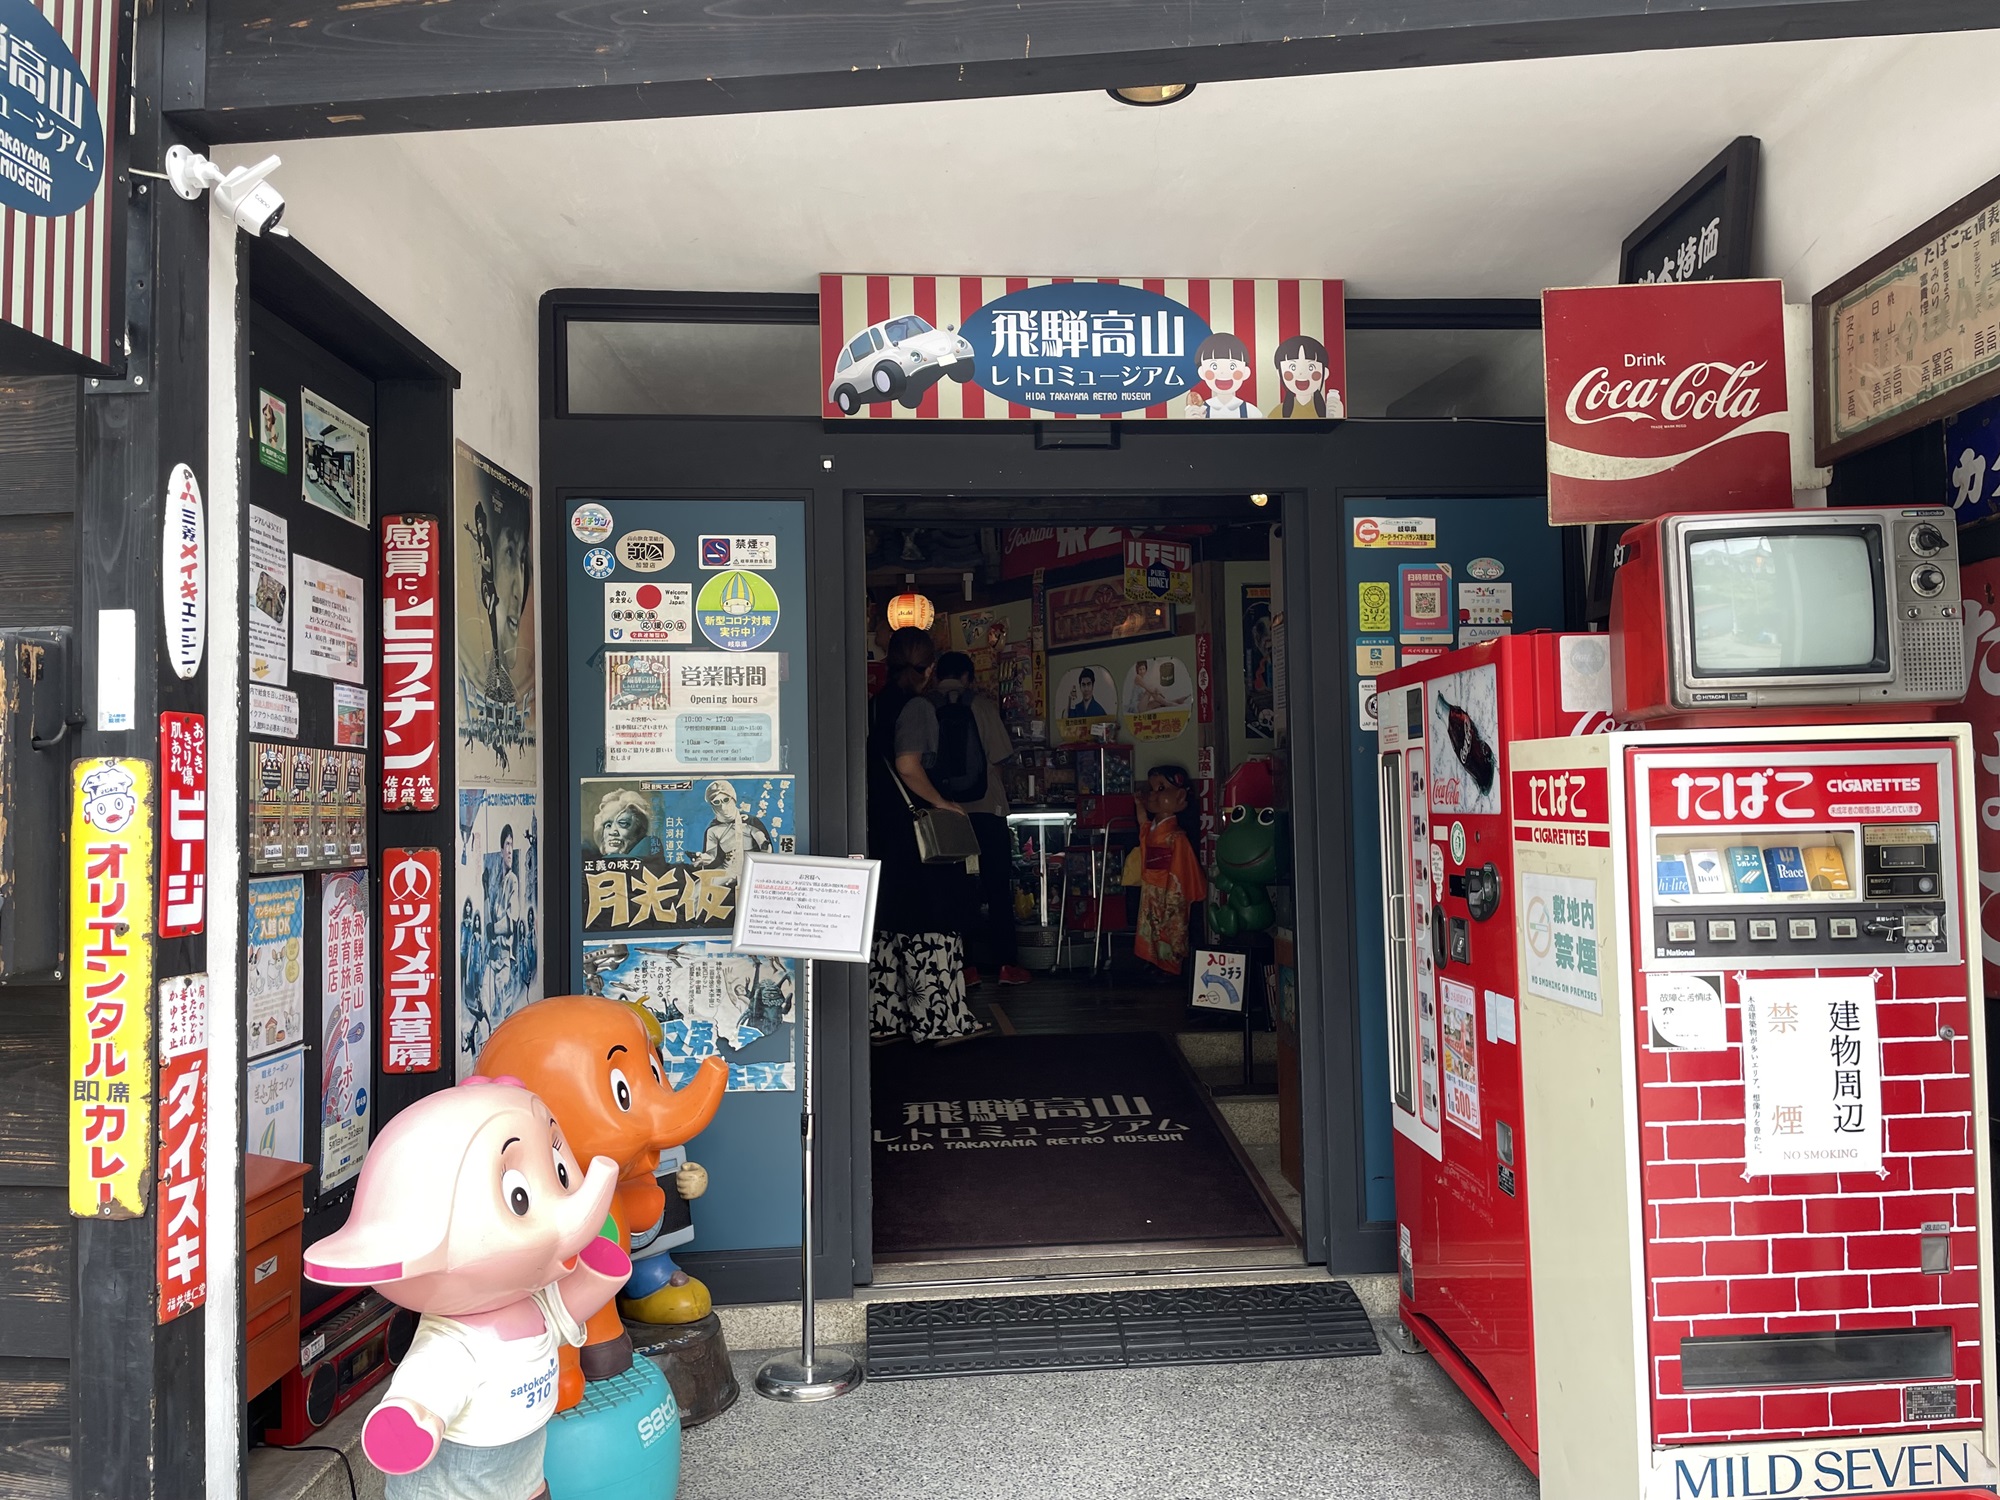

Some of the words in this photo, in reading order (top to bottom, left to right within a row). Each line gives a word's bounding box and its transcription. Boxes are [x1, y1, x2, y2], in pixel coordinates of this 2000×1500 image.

[991, 309, 1185, 358] 飛騨高山
[1624, 354, 1666, 368] Drink
[991, 366, 1185, 388] レトロミュージアム
[1025, 392, 1046, 401] HIDA
[1050, 392, 1089, 401] TAKAYAMA
[1093, 392, 1118, 401] RETRO
[1122, 392, 1151, 401] MUSEUM
[1565, 360, 1768, 425] Coca-Cola
[595, 558, 604, 566] 5
[1128, 542, 1190, 570] ハチミツ
[1148, 577, 1169, 590] HONEY
[704, 615, 772, 626] 新型コロナ対策
[720, 627, 756, 637] 実行中!
[681, 665, 766, 687] 営業時間
[691, 695, 727, 704] Opening
[732, 695, 758, 704] hours
[170, 721, 183, 773] 肌あれ
[182, 730, 194, 787] きり傷
[193, 722, 204, 774] おでき
[1529, 772, 1587, 818] たばこ
[1671, 768, 1815, 820] たばこ
[1827, 778, 1921, 793] CIGARETTES
[1534, 828, 1586, 846] CIGARETTES
[166, 789, 205, 927] ビージ
[584, 859, 641, 871] 正義の味方
[1778, 865, 1804, 879] Peace
[585, 868, 741, 930] 月光仮
[1553, 894, 1594, 930] 敷地内
[85, 843, 130, 1079] オリエンタル
[327, 919, 339, 993] 加盟店
[353, 912, 365, 1010] 飛騨高山
[1554, 932, 1597, 977] 禁煙
[389, 904, 435, 1067] ツバメゴム草履
[1220, 967, 1242, 980] コチラ
[1539, 978, 1561, 992] SMOKING
[1570, 986, 1597, 1001] PREMISES
[1767, 1002, 1805, 1137] 禁煙
[1828, 999, 1865, 1135] 建物周辺
[73, 1080, 130, 1103] 即席
[903, 1095, 1153, 1125] 飛騨高山
[873, 1118, 1190, 1143] レトロミュージアム
[887, 1143, 934, 1152] HIDA
[944, 1139, 1037, 1150] TAKAYAMA
[1047, 1136, 1105, 1146] RETRO
[1113, 1133, 1183, 1143] MUSEUM
[85, 1104, 125, 1203] カレー
[1783, 1150, 1801, 1160] NO
[1804, 1149, 1858, 1160] SMOKING
[167, 1059, 202, 1286] ダイスキ
[526, 1382, 551, 1409] 310
[1675, 1454, 1803, 1500] MILD
[1814, 1442, 1969, 1492] SEVEN
